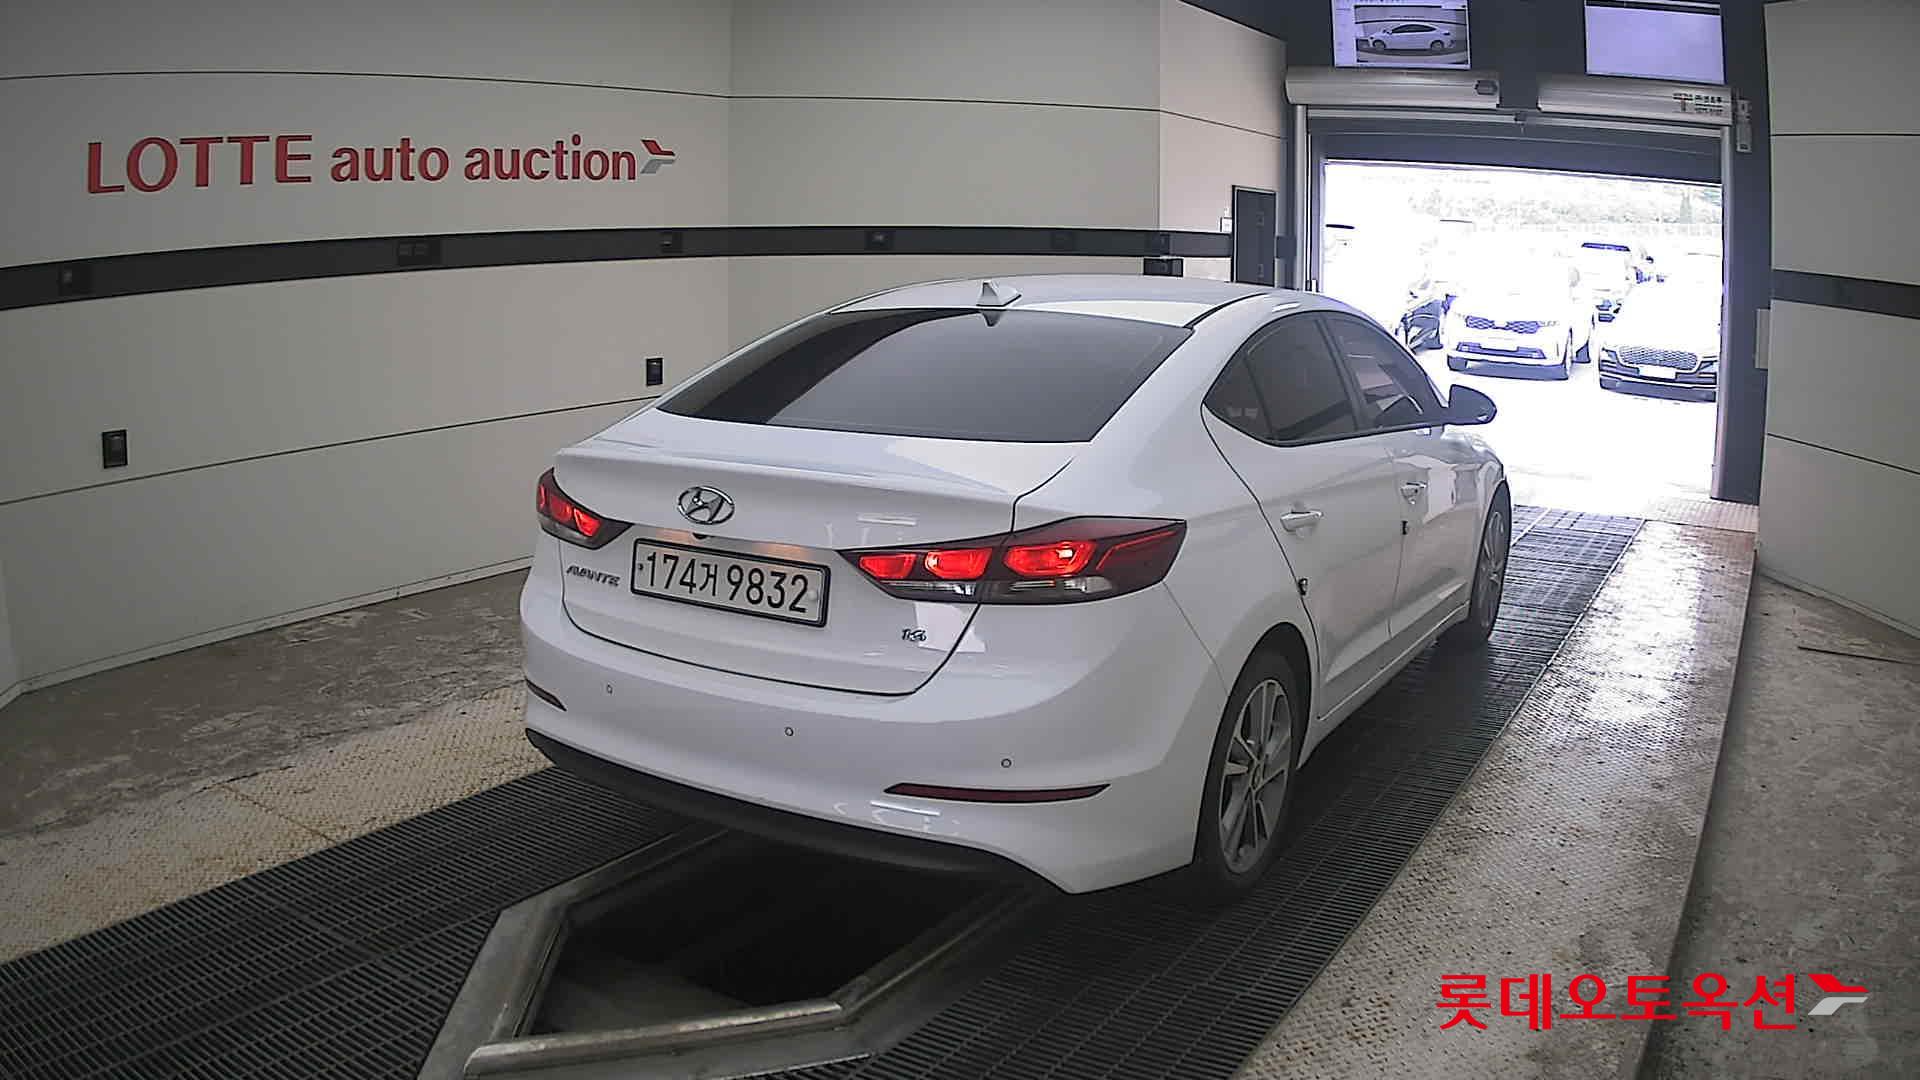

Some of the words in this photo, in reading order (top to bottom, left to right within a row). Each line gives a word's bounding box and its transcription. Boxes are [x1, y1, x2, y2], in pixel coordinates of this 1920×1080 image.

[88, 135, 312, 194] LOTTE
[331, 137, 450, 182] auto
[464, 134, 637, 181] auction
[647, 551, 718, 597] 174거
[727, 564, 808, 613] 9832
